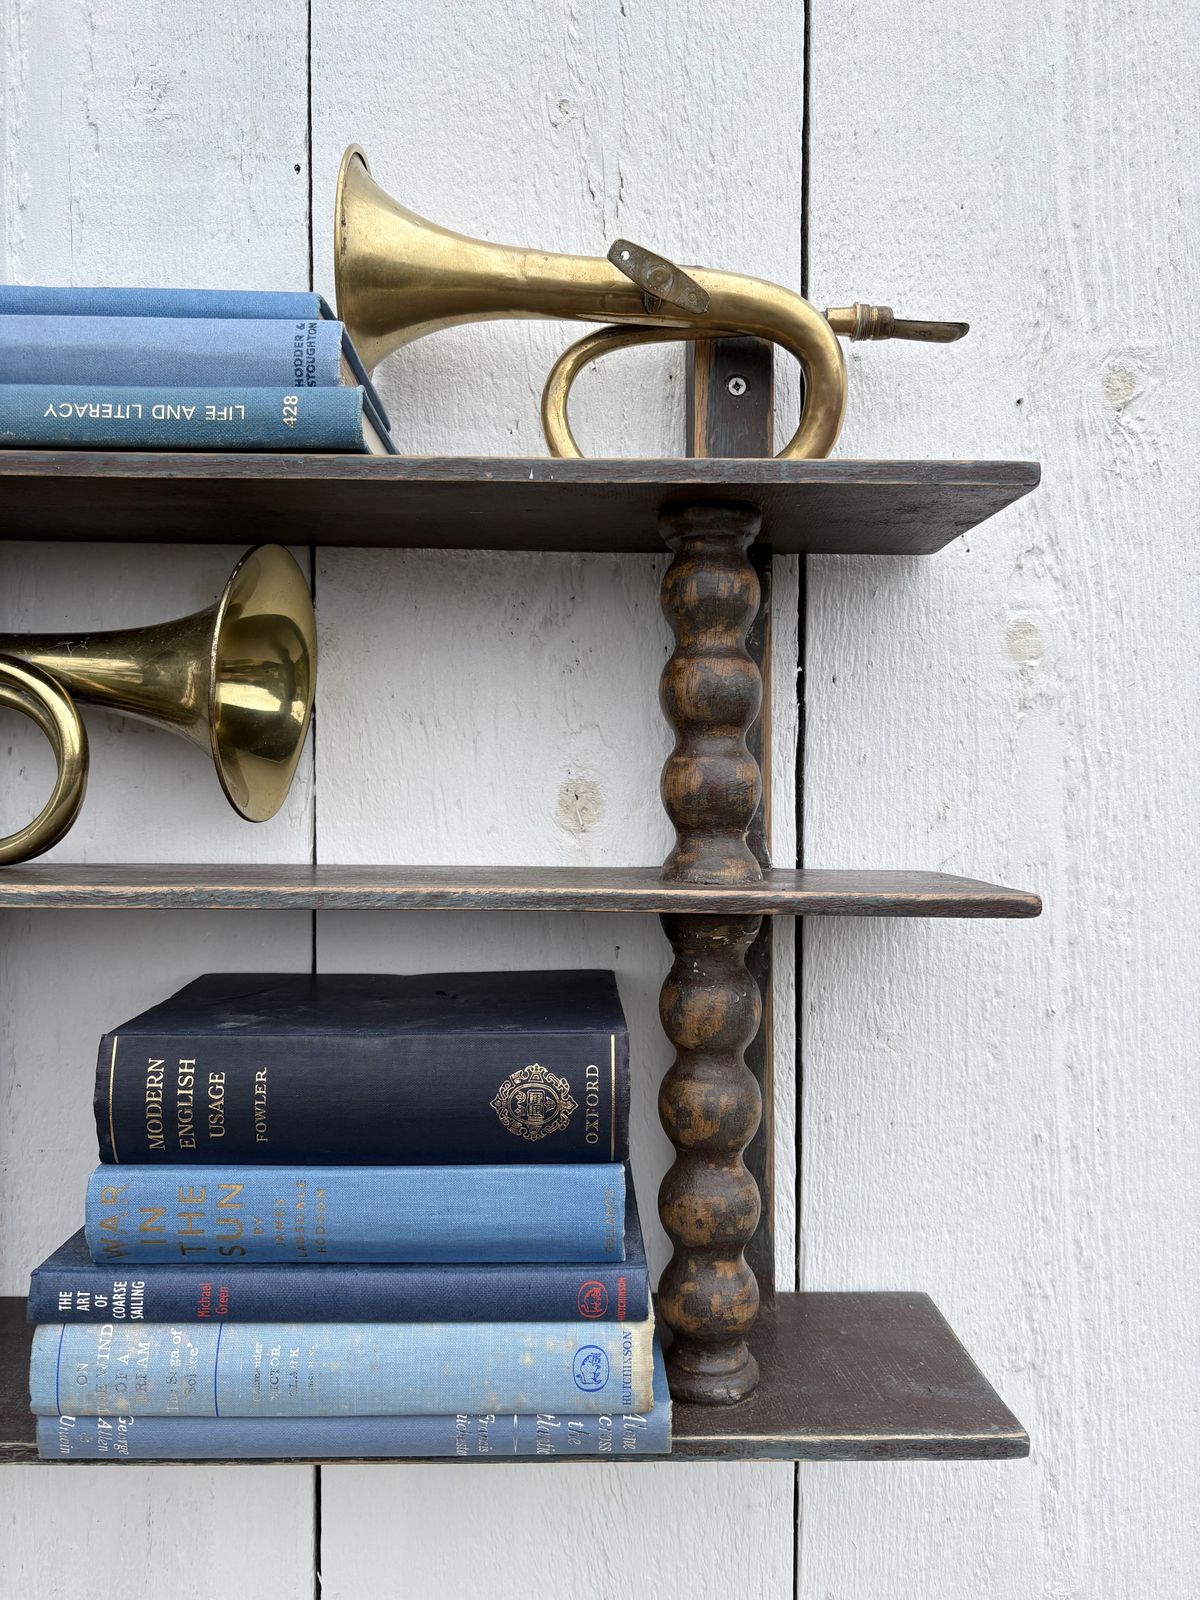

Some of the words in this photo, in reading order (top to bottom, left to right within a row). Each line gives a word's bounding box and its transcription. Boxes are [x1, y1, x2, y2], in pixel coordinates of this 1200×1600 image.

[299, 322, 307, 332] &
[294, 333, 305, 387] HODDER
[306, 322, 318, 387] STOUGHTON
[43, 403, 143, 419] LITERACY
[152, 404, 197, 421] AND
[205, 404, 246, 421] LIFE
[282, 394, 299, 429] 428
[145, 1057, 166, 1151] MODERN
[177, 1058, 196, 1150] ENGLISH
[208, 1071, 226, 1139] USAGE
[254, 1066, 269, 1143] FOWLER
[585, 1064, 599, 1144] OXFORD
[100, 1183, 129, 1260] WAR
[138, 1206, 168, 1245] IN
[176, 1185, 208, 1256] THE
[215, 1182, 246, 1257] SUN
[253, 1215, 265, 1236] BY
[58, 1291, 73, 1311] THE
[76, 1290, 91, 1312] ART
[94, 1294, 108, 1308] OF
[112, 1280, 128, 1319] COARSE
[130, 1280, 145, 1320] SAILING
[196, 1282, 212, 1319] Michael
[215, 1286, 230, 1315] Green
[616, 1276, 627, 1321] HUTCHINSON
[96, 1324, 114, 1378] WIND
[170, 1327, 183, 1344] of
[76, 1362, 89, 1386] ON
[117, 1353, 129, 1365] A
[622, 1330, 633, 1406] HUTCHINSON
[97, 1417, 114, 1453] Allen
[536, 1414, 560, 1455] tlantic
[567, 1421, 591, 1446] the
[598, 1413, 613, 1452] cross
